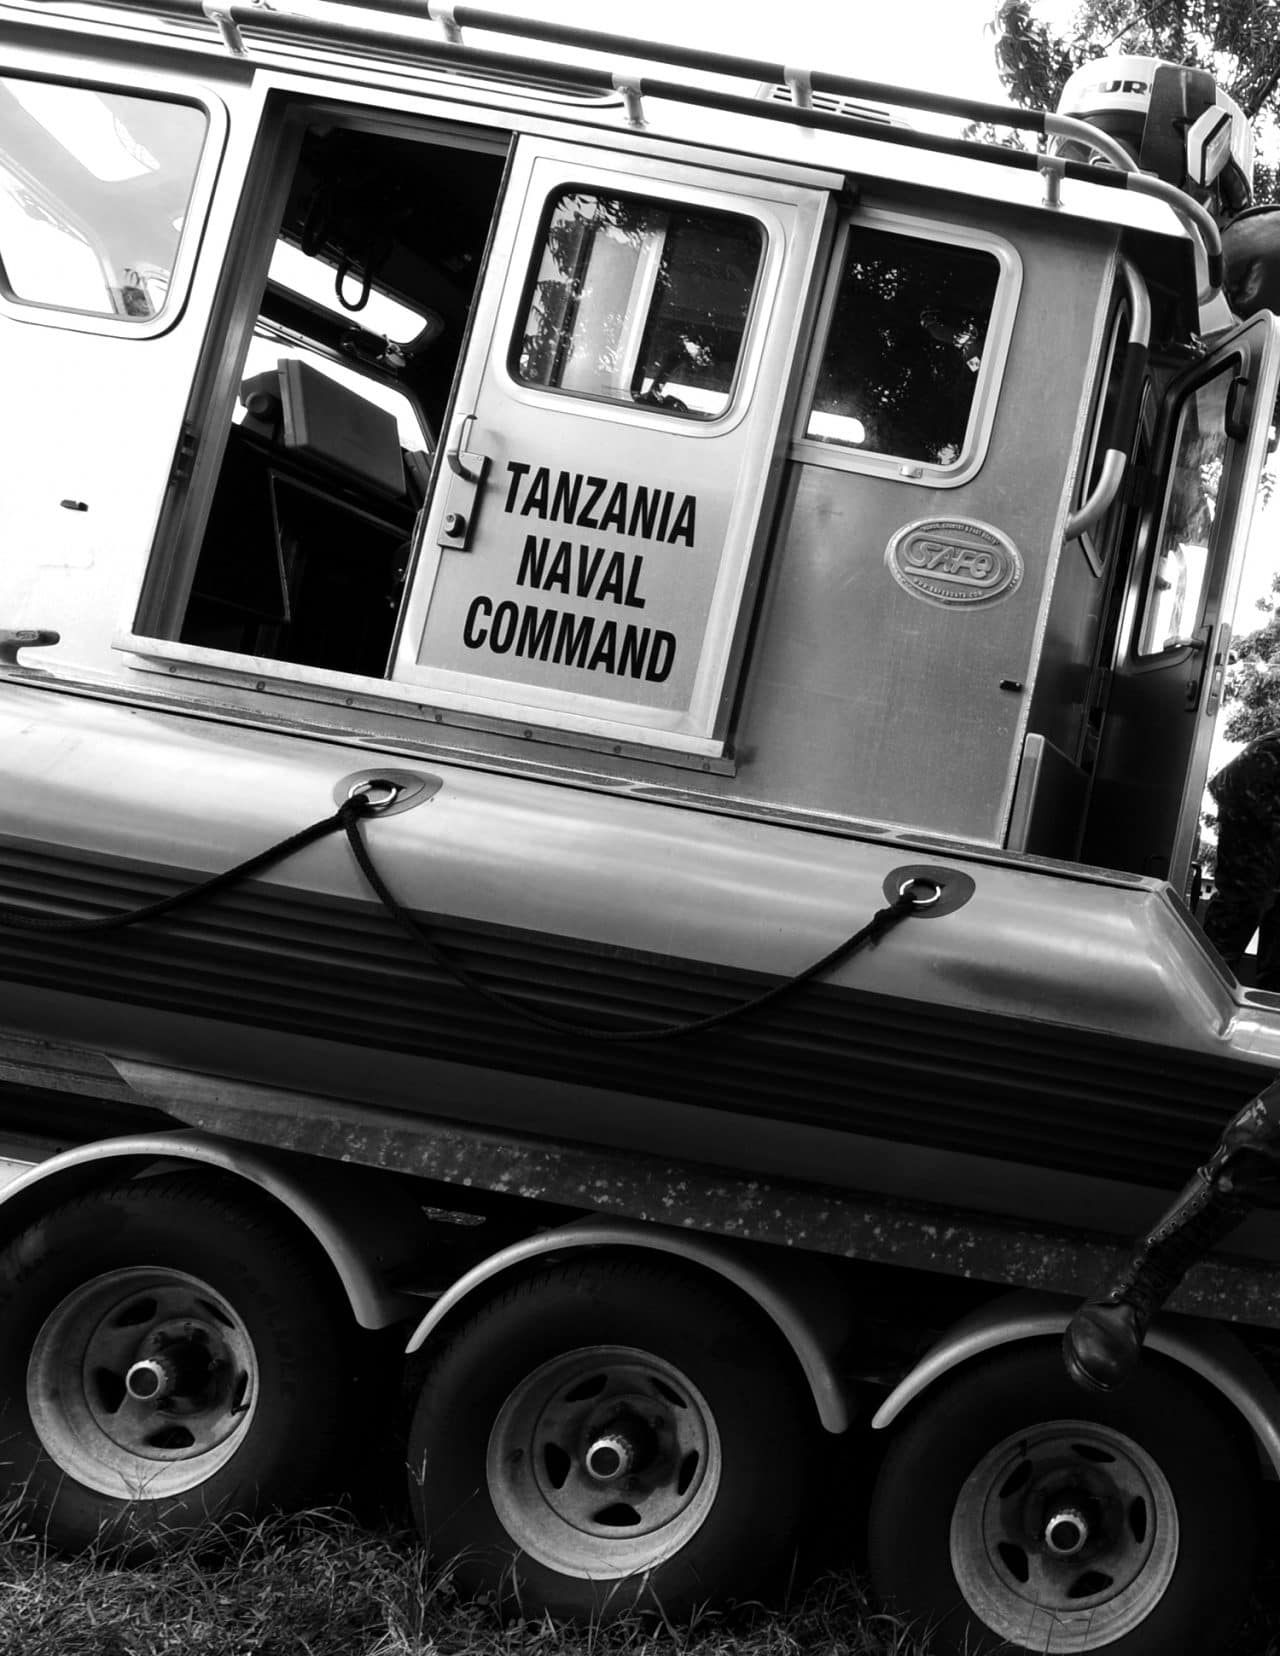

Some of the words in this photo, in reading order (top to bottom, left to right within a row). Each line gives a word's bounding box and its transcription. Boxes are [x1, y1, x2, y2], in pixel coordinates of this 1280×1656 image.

[504, 461, 697, 548] TANZANIA
[516, 534, 646, 609] NAVAL
[463, 595, 677, 683] COMMAND
